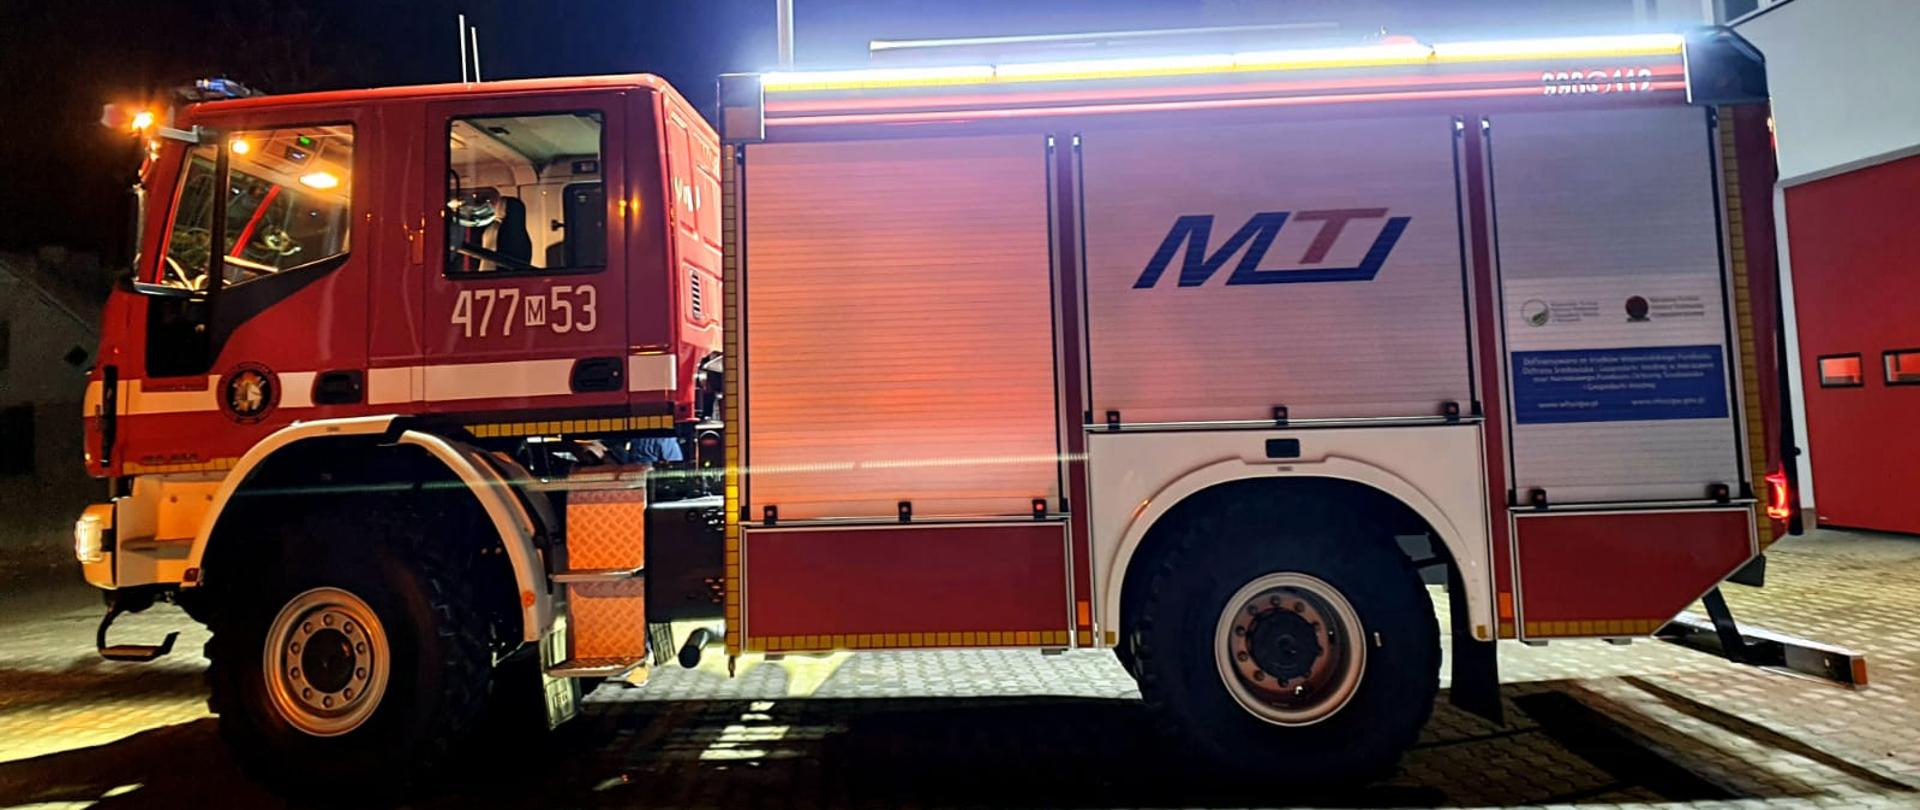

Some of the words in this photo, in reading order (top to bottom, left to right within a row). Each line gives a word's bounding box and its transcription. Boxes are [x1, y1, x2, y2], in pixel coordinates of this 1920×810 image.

[452, 288, 520, 338] 477
[525, 296, 546, 327] M
[551, 284, 597, 333] 53
